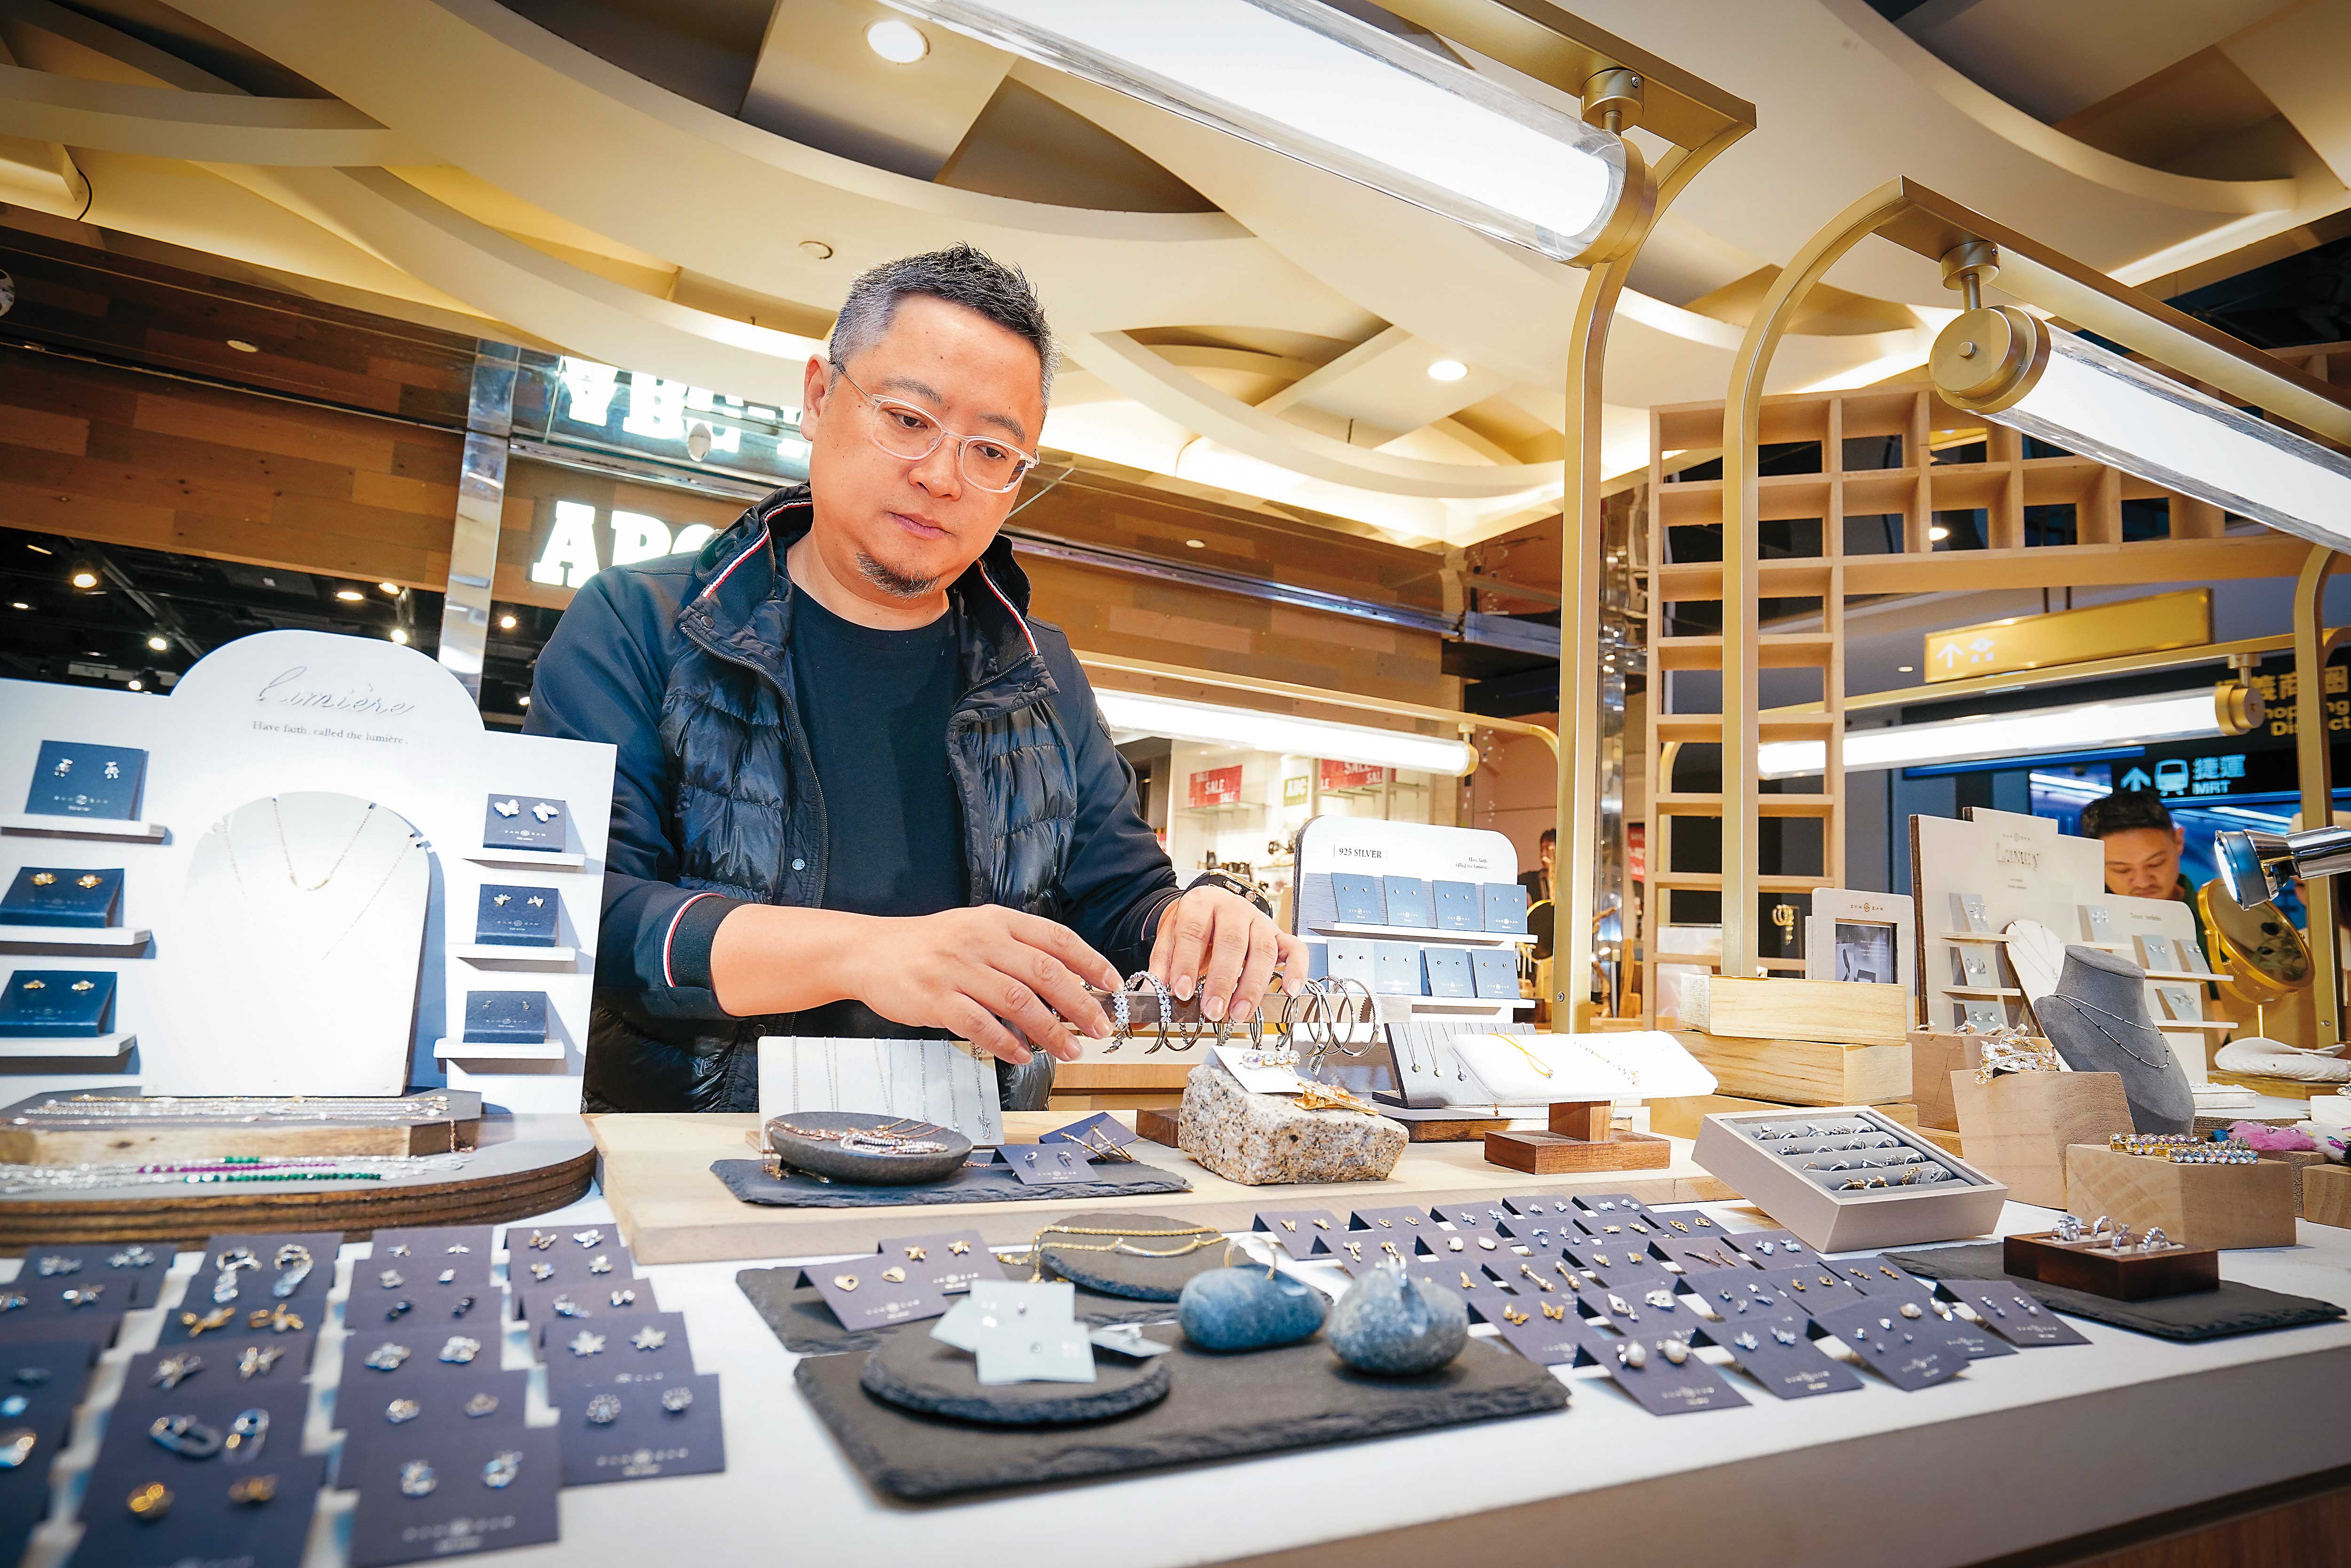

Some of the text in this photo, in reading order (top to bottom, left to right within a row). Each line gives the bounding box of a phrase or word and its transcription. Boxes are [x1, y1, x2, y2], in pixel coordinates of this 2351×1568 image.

[252, 720, 280, 732] Have
[314, 728, 343, 738] called
[347, 731, 363, 741] the
[2193, 754, 2246, 780] 捷運
[1205, 779, 1225, 795] SALE
[2192, 780, 2231, 795] MRT
[1354, 849, 1382, 858] SILVER
